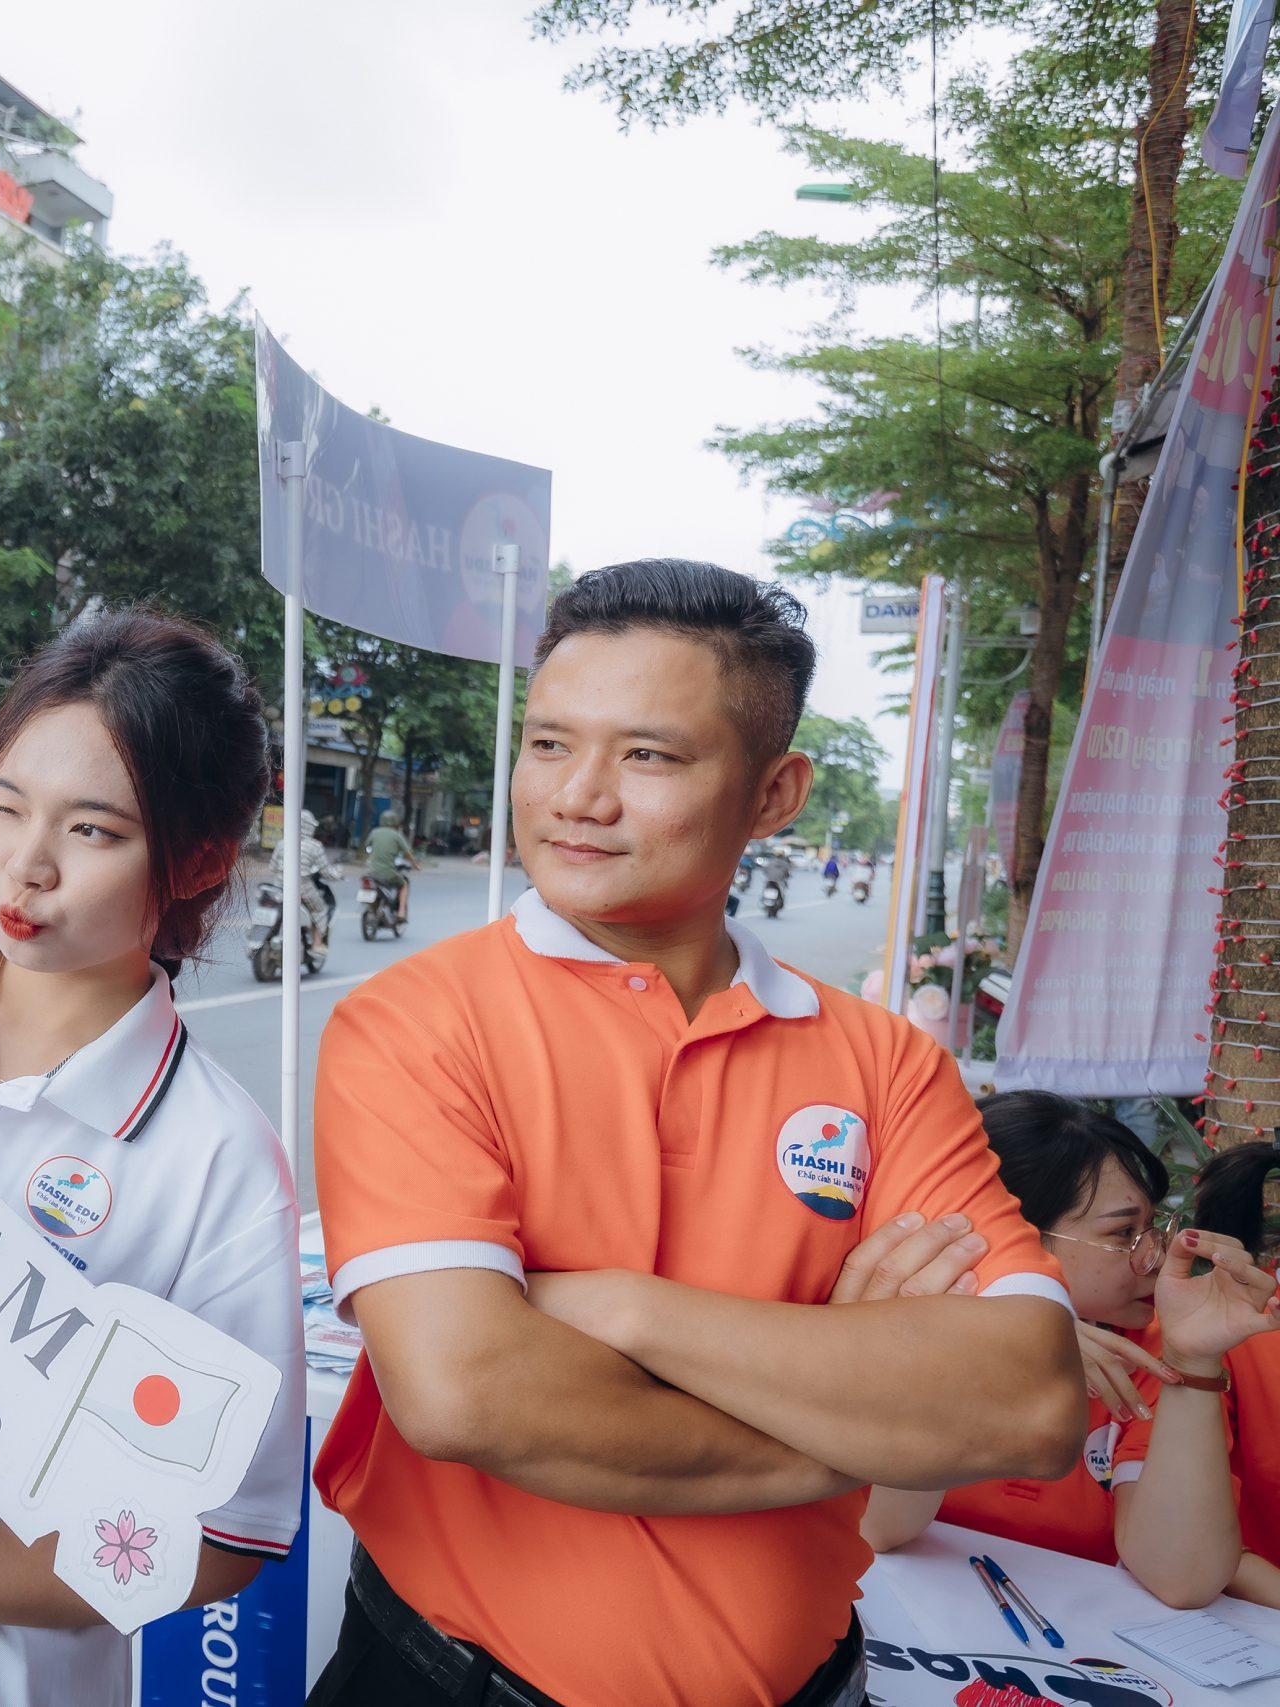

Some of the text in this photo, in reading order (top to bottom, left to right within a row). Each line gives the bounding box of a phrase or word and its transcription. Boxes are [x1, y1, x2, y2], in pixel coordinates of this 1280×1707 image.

[791, 1153, 867, 1183] HASHI EDU
[38, 1180, 100, 1222] HASHI EDU
[201, 1593, 239, 1707] ROU
